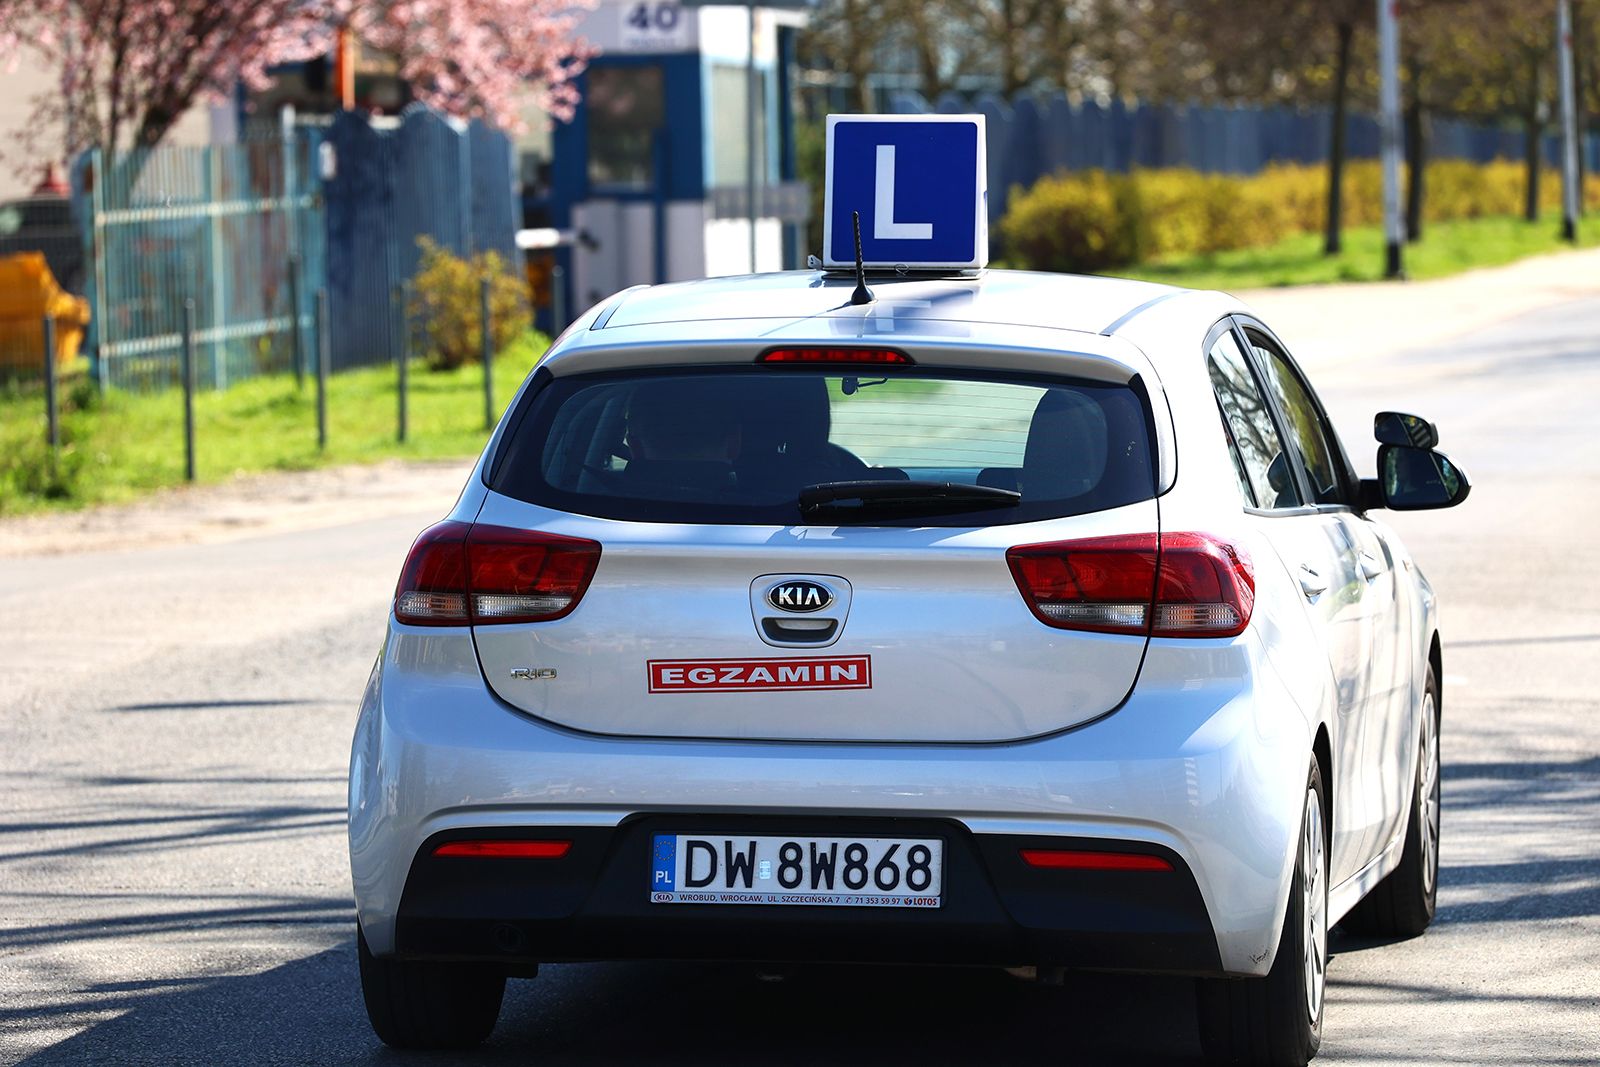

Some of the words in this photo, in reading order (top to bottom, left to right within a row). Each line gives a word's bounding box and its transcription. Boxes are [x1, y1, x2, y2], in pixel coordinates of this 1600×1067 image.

[626, 1, 680, 31] 40
[874, 144, 933, 240] L
[778, 586, 822, 606] KIA
[510, 667, 558, 680] RIO
[661, 664, 858, 685] EGZAMIN
[685, 840, 757, 888] DW
[777, 841, 932, 892] 8W868
[655, 870, 672, 884] PL
[656, 893, 672, 902] KIA
[767, 895, 780, 903] UL.
[781, 894, 834, 904] SZCZECIŃSKA
[835, 896, 841, 904] 7
[855, 896, 864, 904] 71
[865, 896, 879, 905] 353
[881, 897, 890, 905] 59
[891, 897, 901, 905] 97
[913, 897, 938, 906] LOTOS
